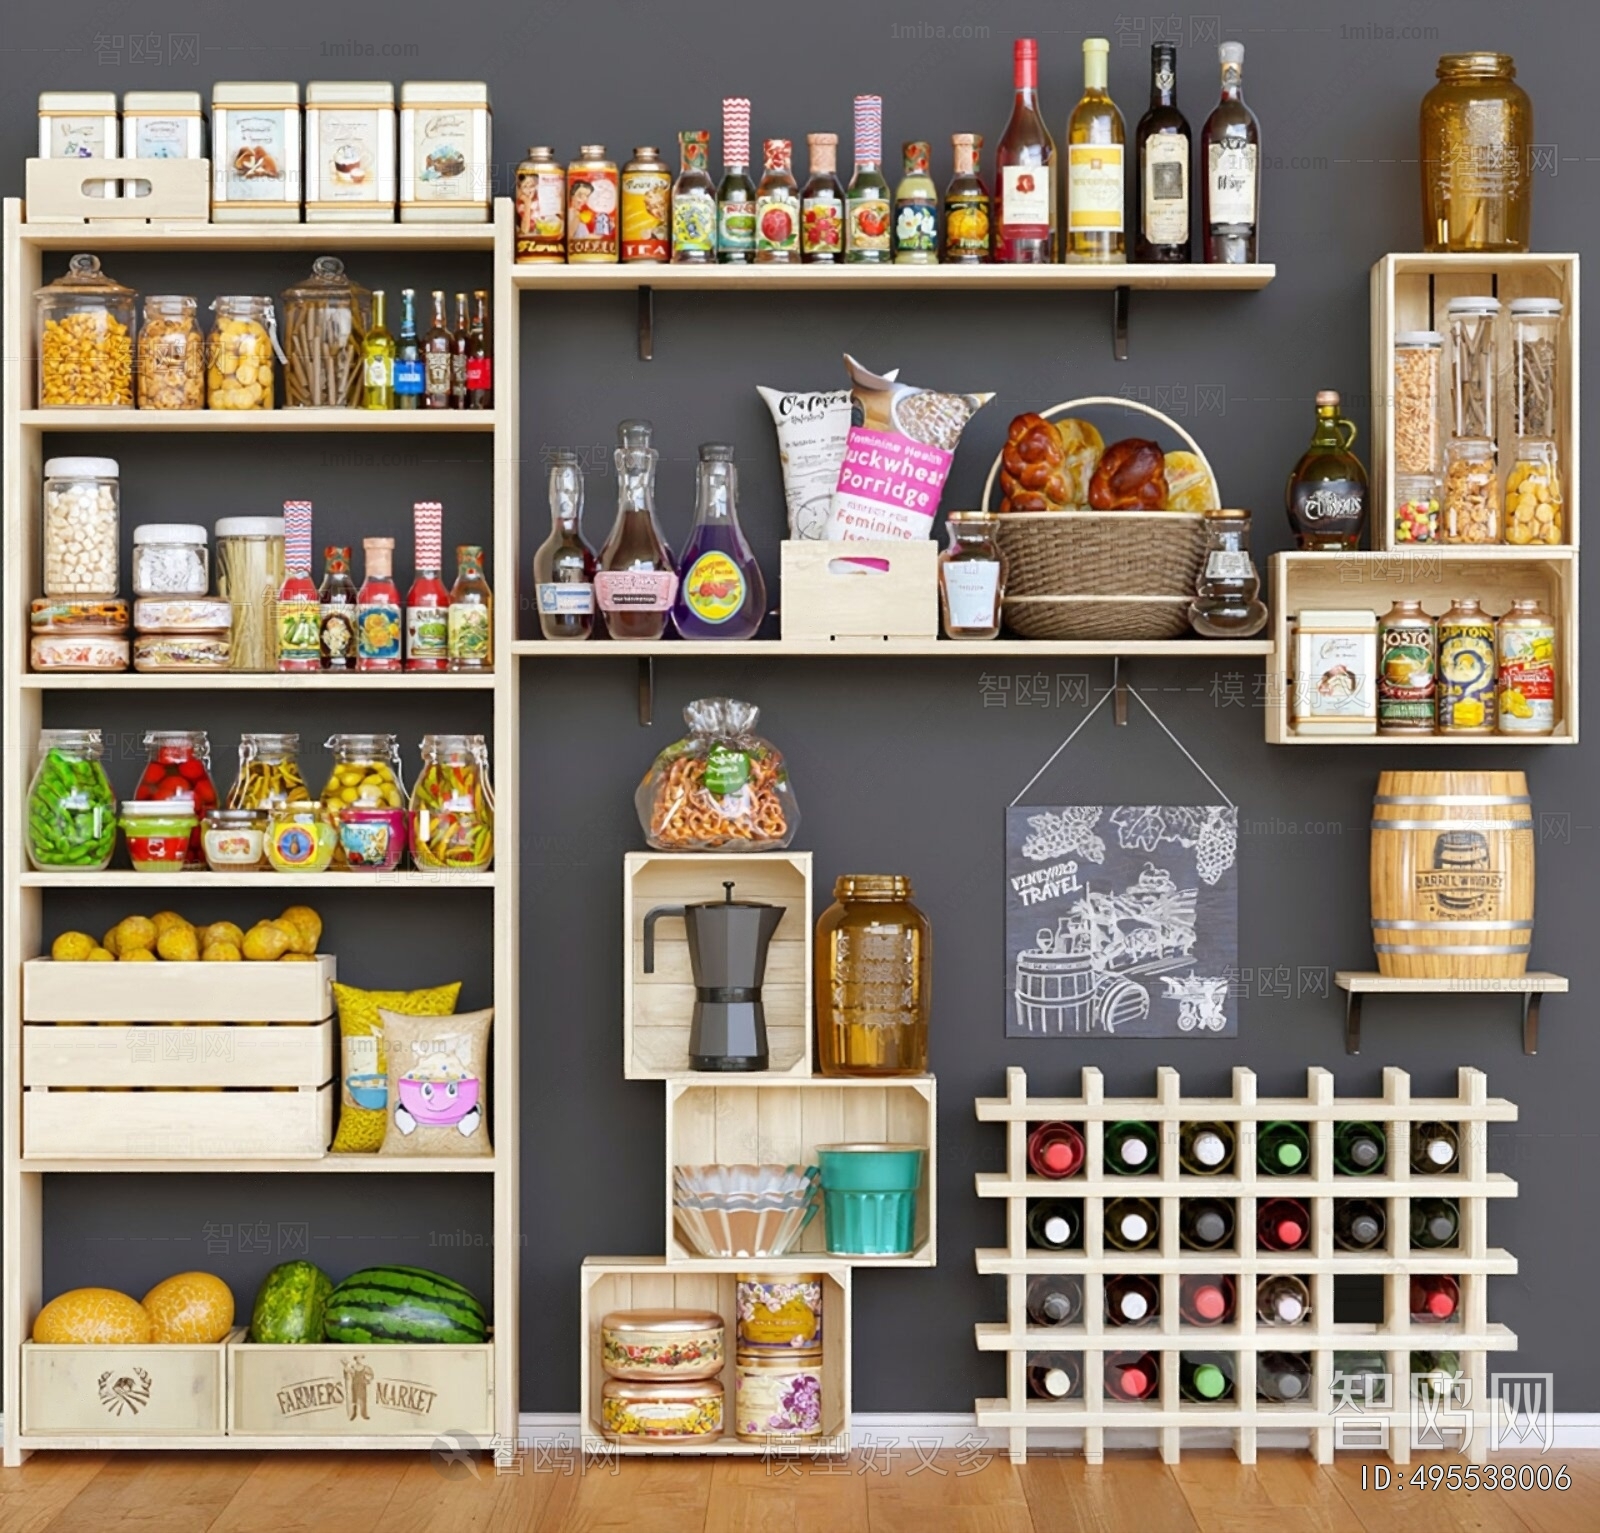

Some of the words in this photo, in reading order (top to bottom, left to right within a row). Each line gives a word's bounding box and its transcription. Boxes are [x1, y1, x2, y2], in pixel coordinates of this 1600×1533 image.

[625, 244, 666, 256] TEA
[841, 468, 930, 507] Porridge
[836, 508, 913, 540] Feminine
[1018, 875, 1083, 906] TRAVEL
[276, 1381, 345, 1414] FARMERS
[375, 1381, 437, 1414] MARKET
